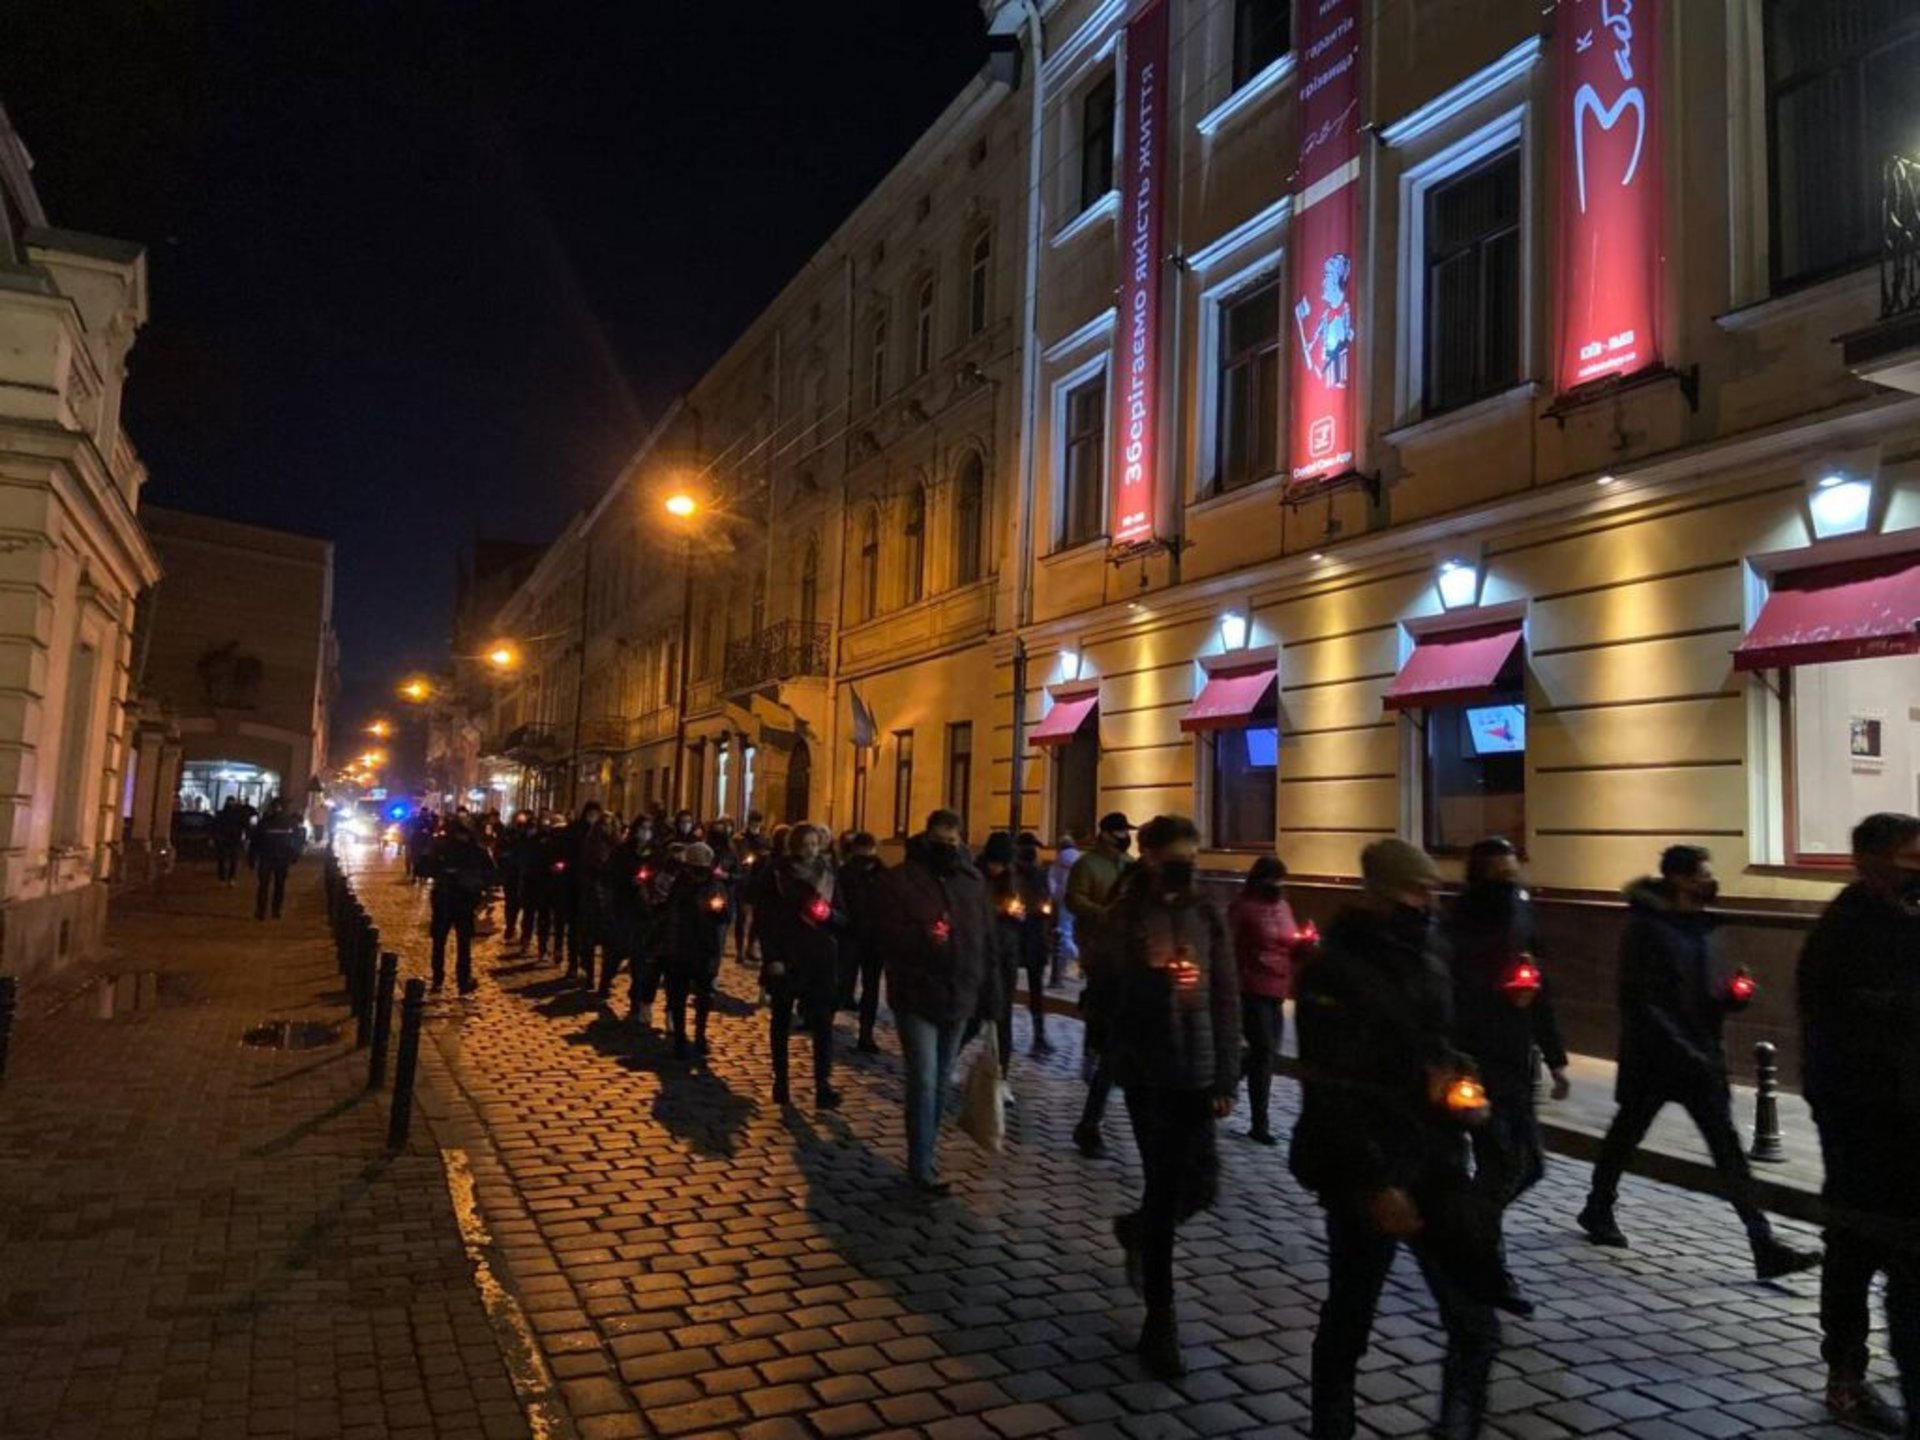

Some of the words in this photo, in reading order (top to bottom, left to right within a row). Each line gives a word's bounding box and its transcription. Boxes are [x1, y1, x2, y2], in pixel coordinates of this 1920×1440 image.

[1139, 62, 1154, 173] життя
[1132, 177, 1150, 282] якість
[1125, 290, 1147, 485] Зберігаємо
